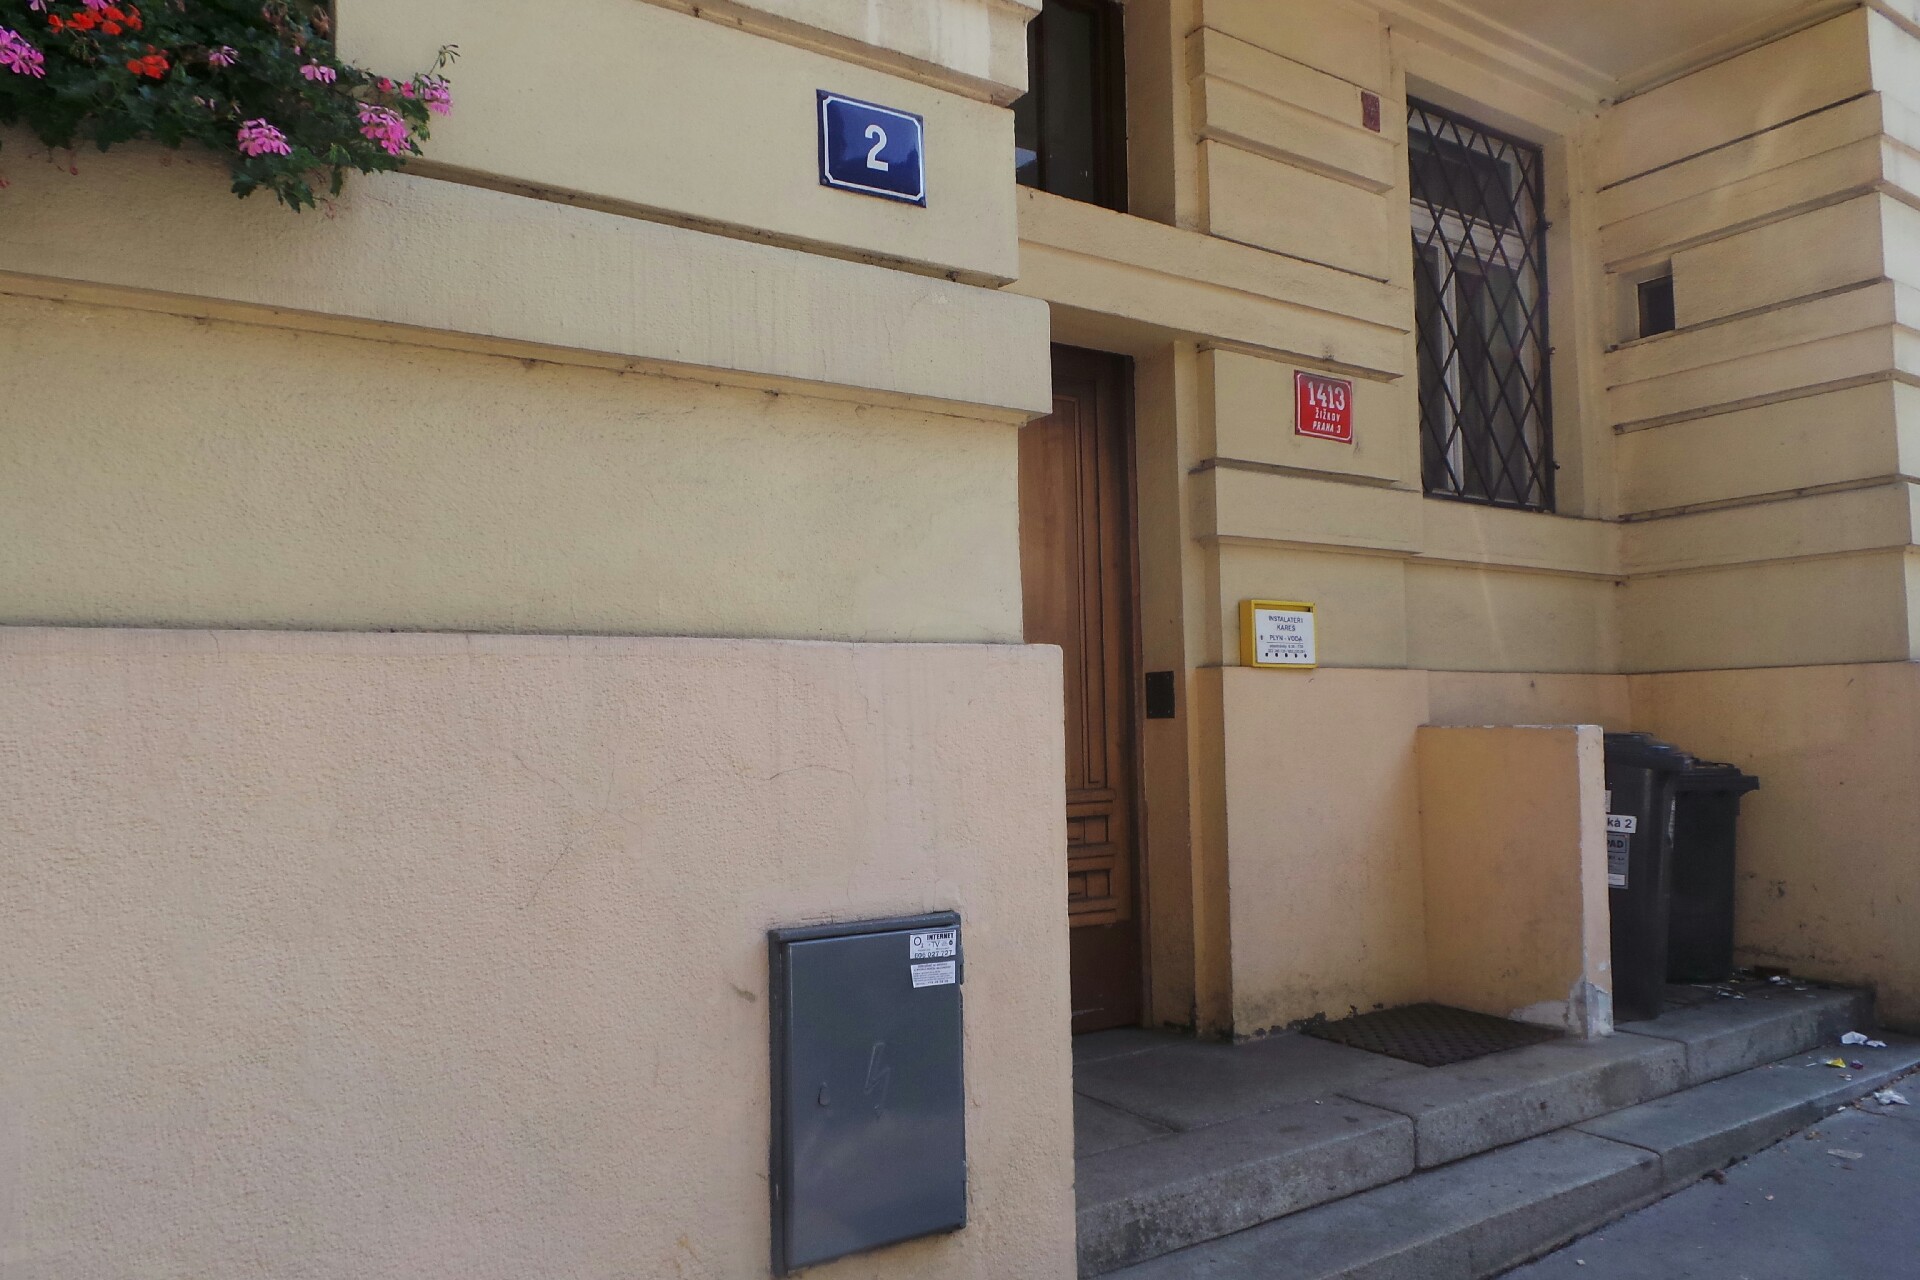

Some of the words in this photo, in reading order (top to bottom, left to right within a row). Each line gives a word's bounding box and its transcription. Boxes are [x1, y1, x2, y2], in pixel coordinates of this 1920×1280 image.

[865, 124, 888, 171] 2
[1308, 381, 1345, 410] 1413
[1315, 407, 1340, 422] ŽIŽKOV
[1313, 421, 1334, 432] PRAHA
[1337, 425, 1341, 433] 3
[1624, 818, 1632, 829] 2
